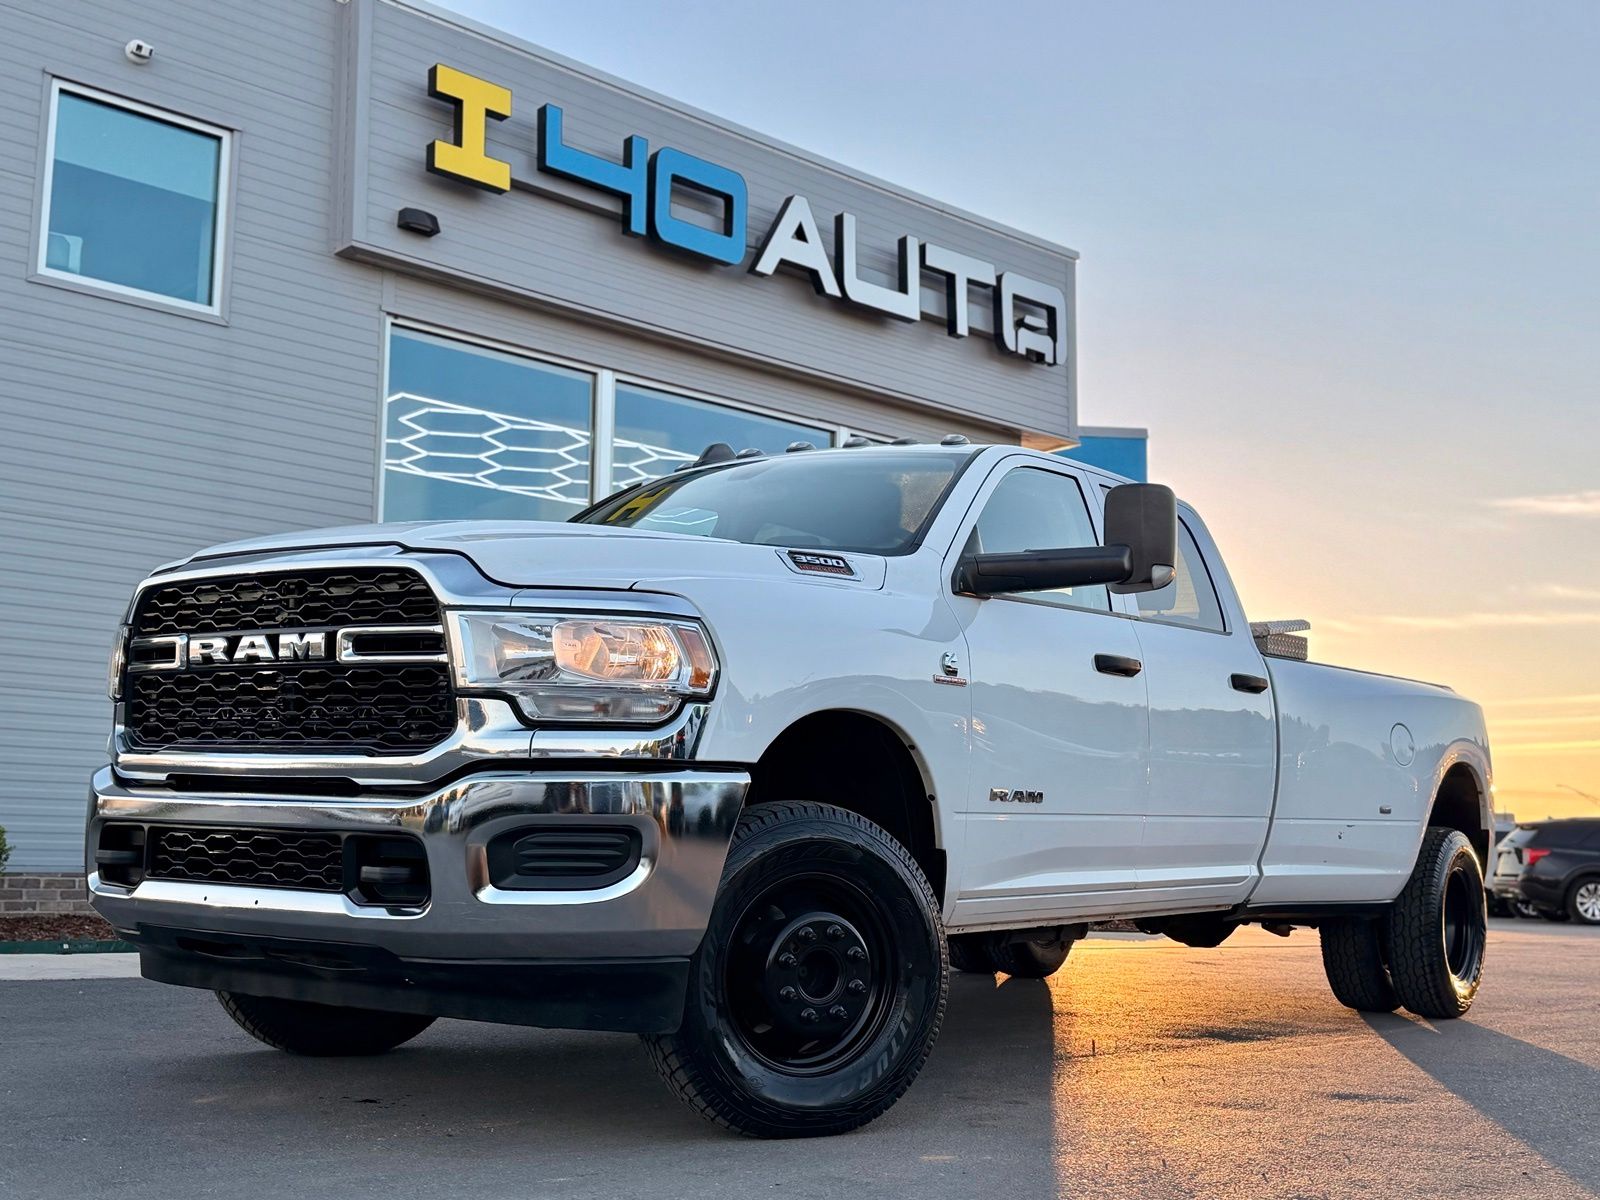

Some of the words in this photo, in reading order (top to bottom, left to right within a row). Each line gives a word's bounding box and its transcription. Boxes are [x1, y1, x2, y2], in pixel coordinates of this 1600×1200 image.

[428, 63, 512, 194] I
[538, 103, 748, 266] 40
[794, 555, 845, 567] 3500
[189, 633, 327, 663] RAM
[989, 787, 1044, 804] RAM
